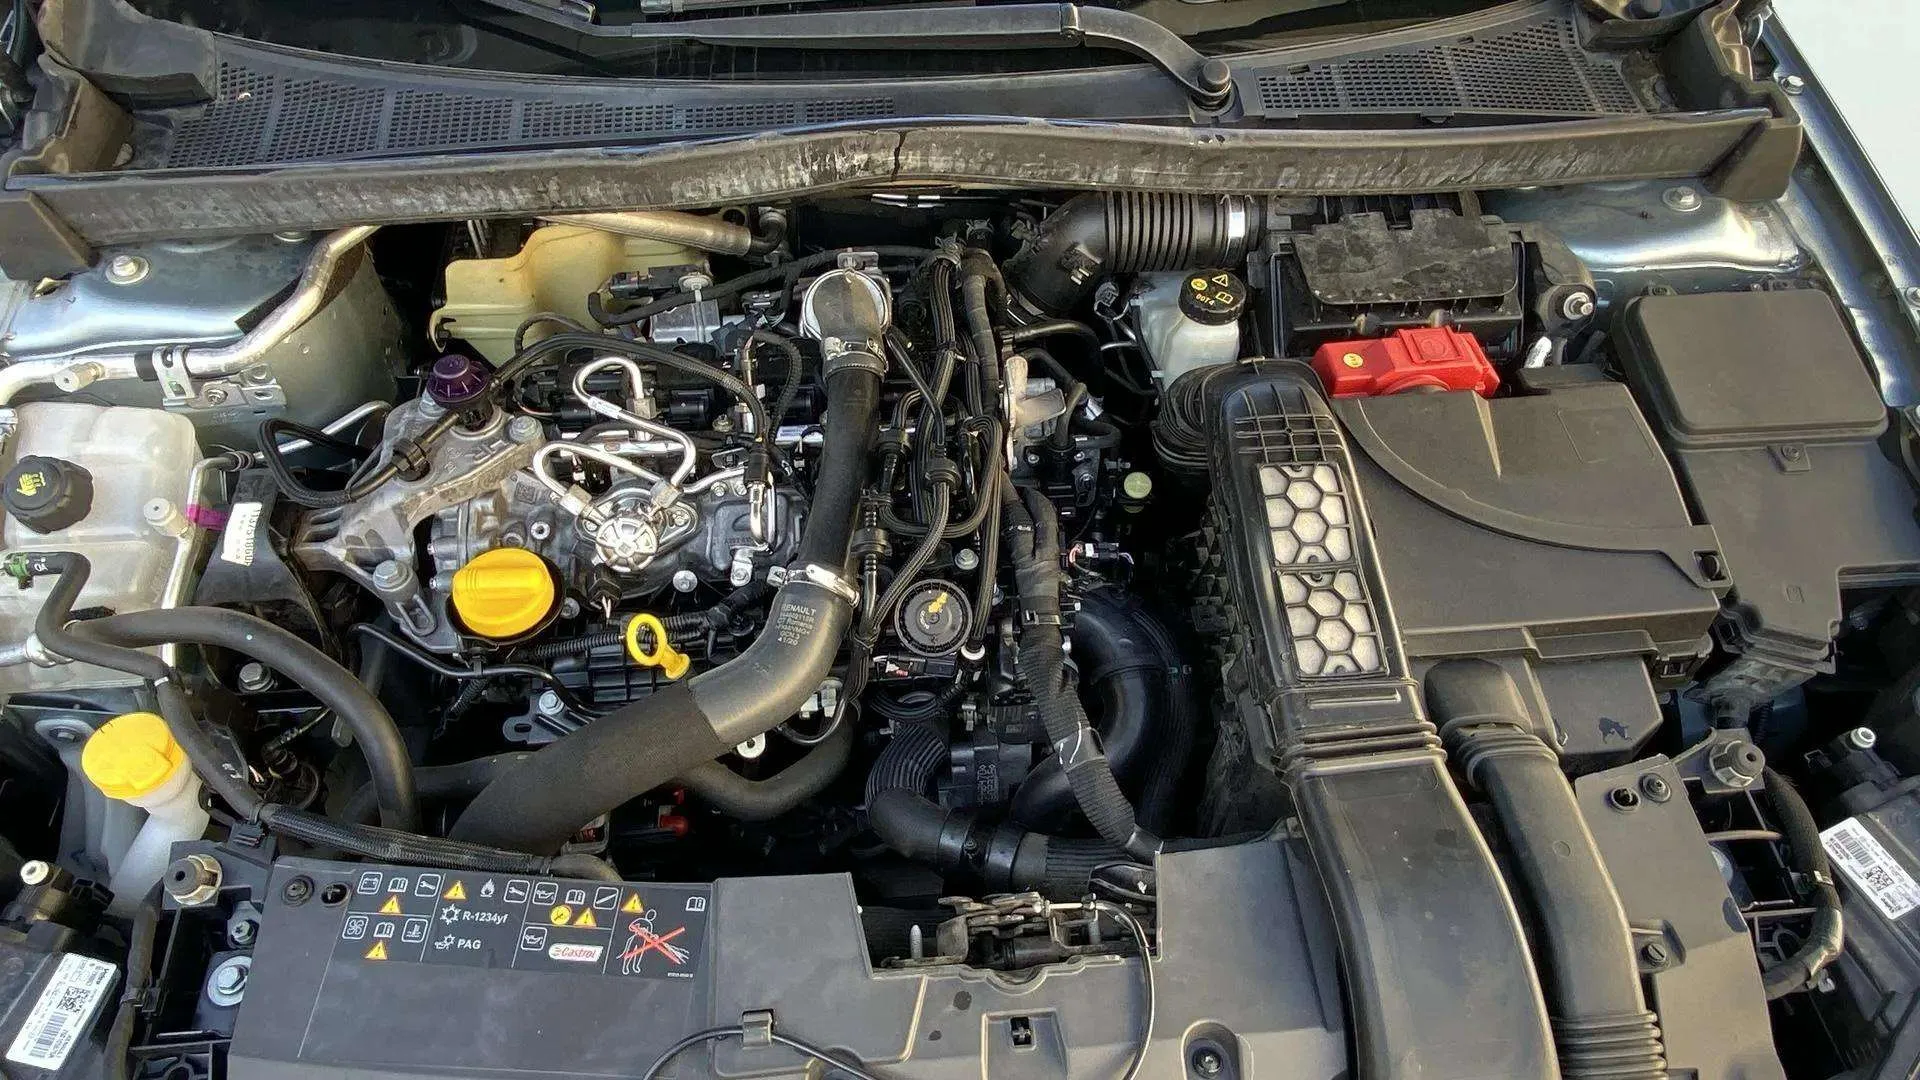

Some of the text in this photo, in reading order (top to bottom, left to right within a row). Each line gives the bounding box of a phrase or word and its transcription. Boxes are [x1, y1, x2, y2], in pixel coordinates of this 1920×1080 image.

[781, 603, 817, 616] RENAULT
[462, 910, 509, 925] R-1234yf
[457, 938, 482, 950] PAG
[560, 945, 598, 959] Castrol
